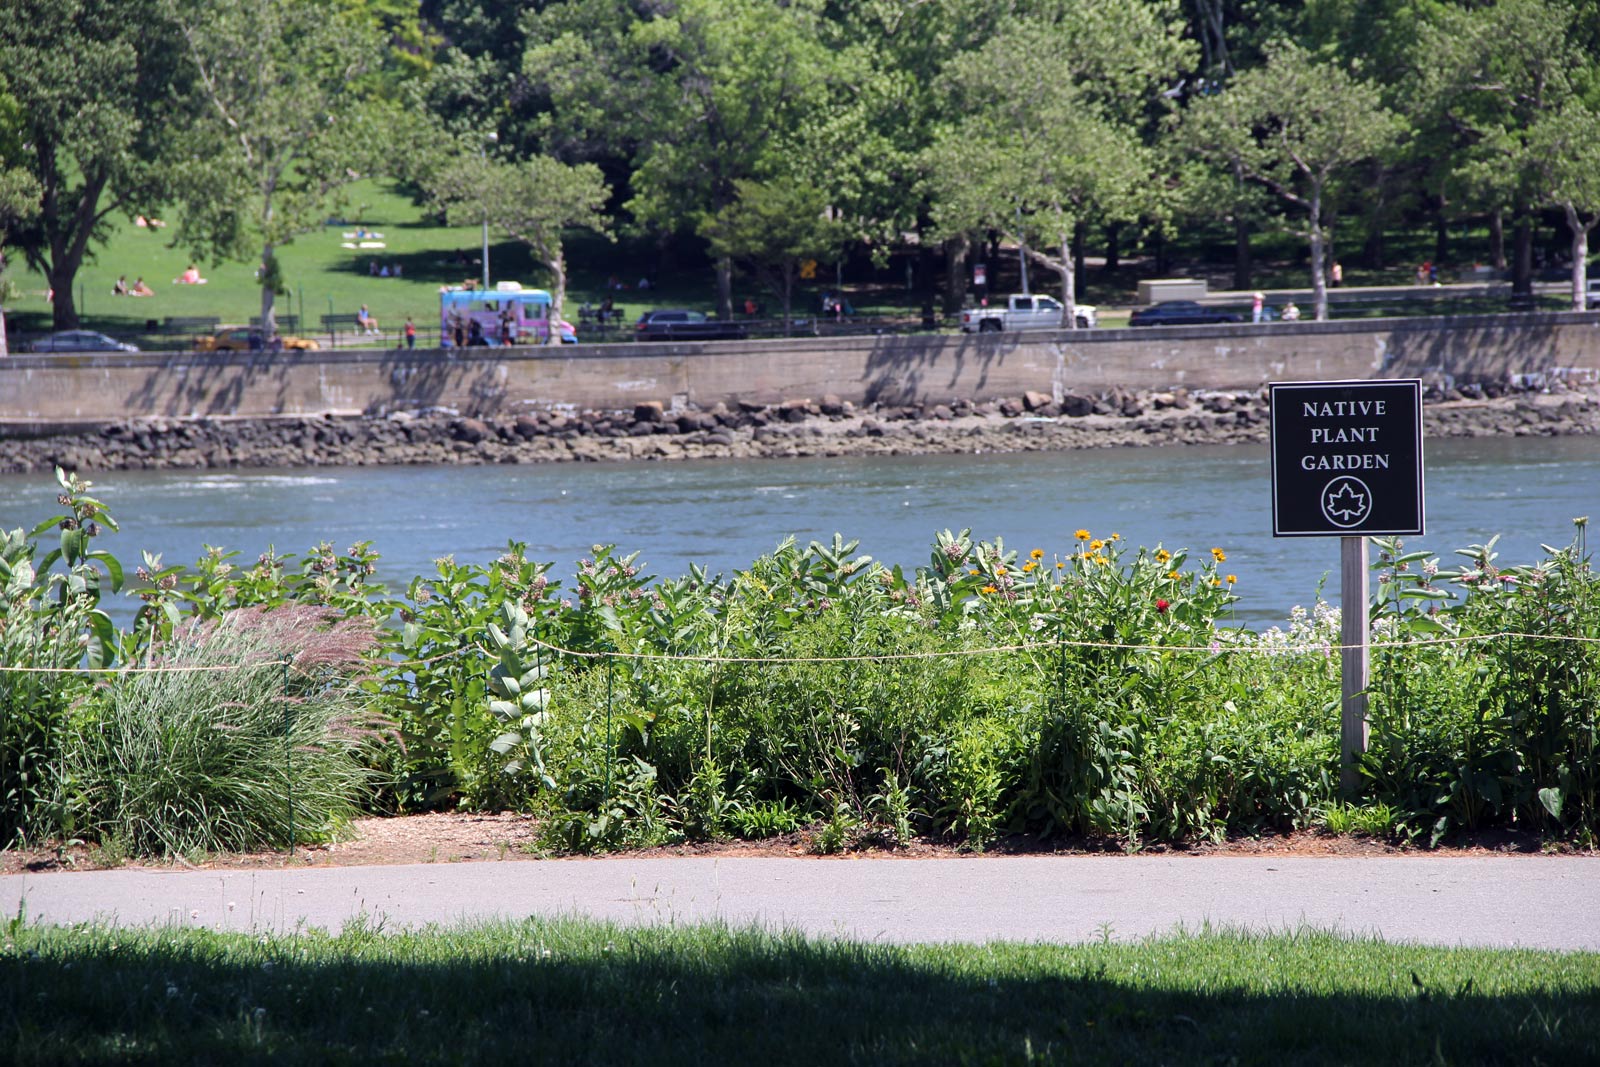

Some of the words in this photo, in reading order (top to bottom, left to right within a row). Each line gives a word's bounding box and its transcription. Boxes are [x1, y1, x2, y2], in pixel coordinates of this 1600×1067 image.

[1303, 401, 1386, 417] NATIVE
[1311, 428, 1380, 444] PLANT
[1301, 454, 1390, 470] GARDEN
